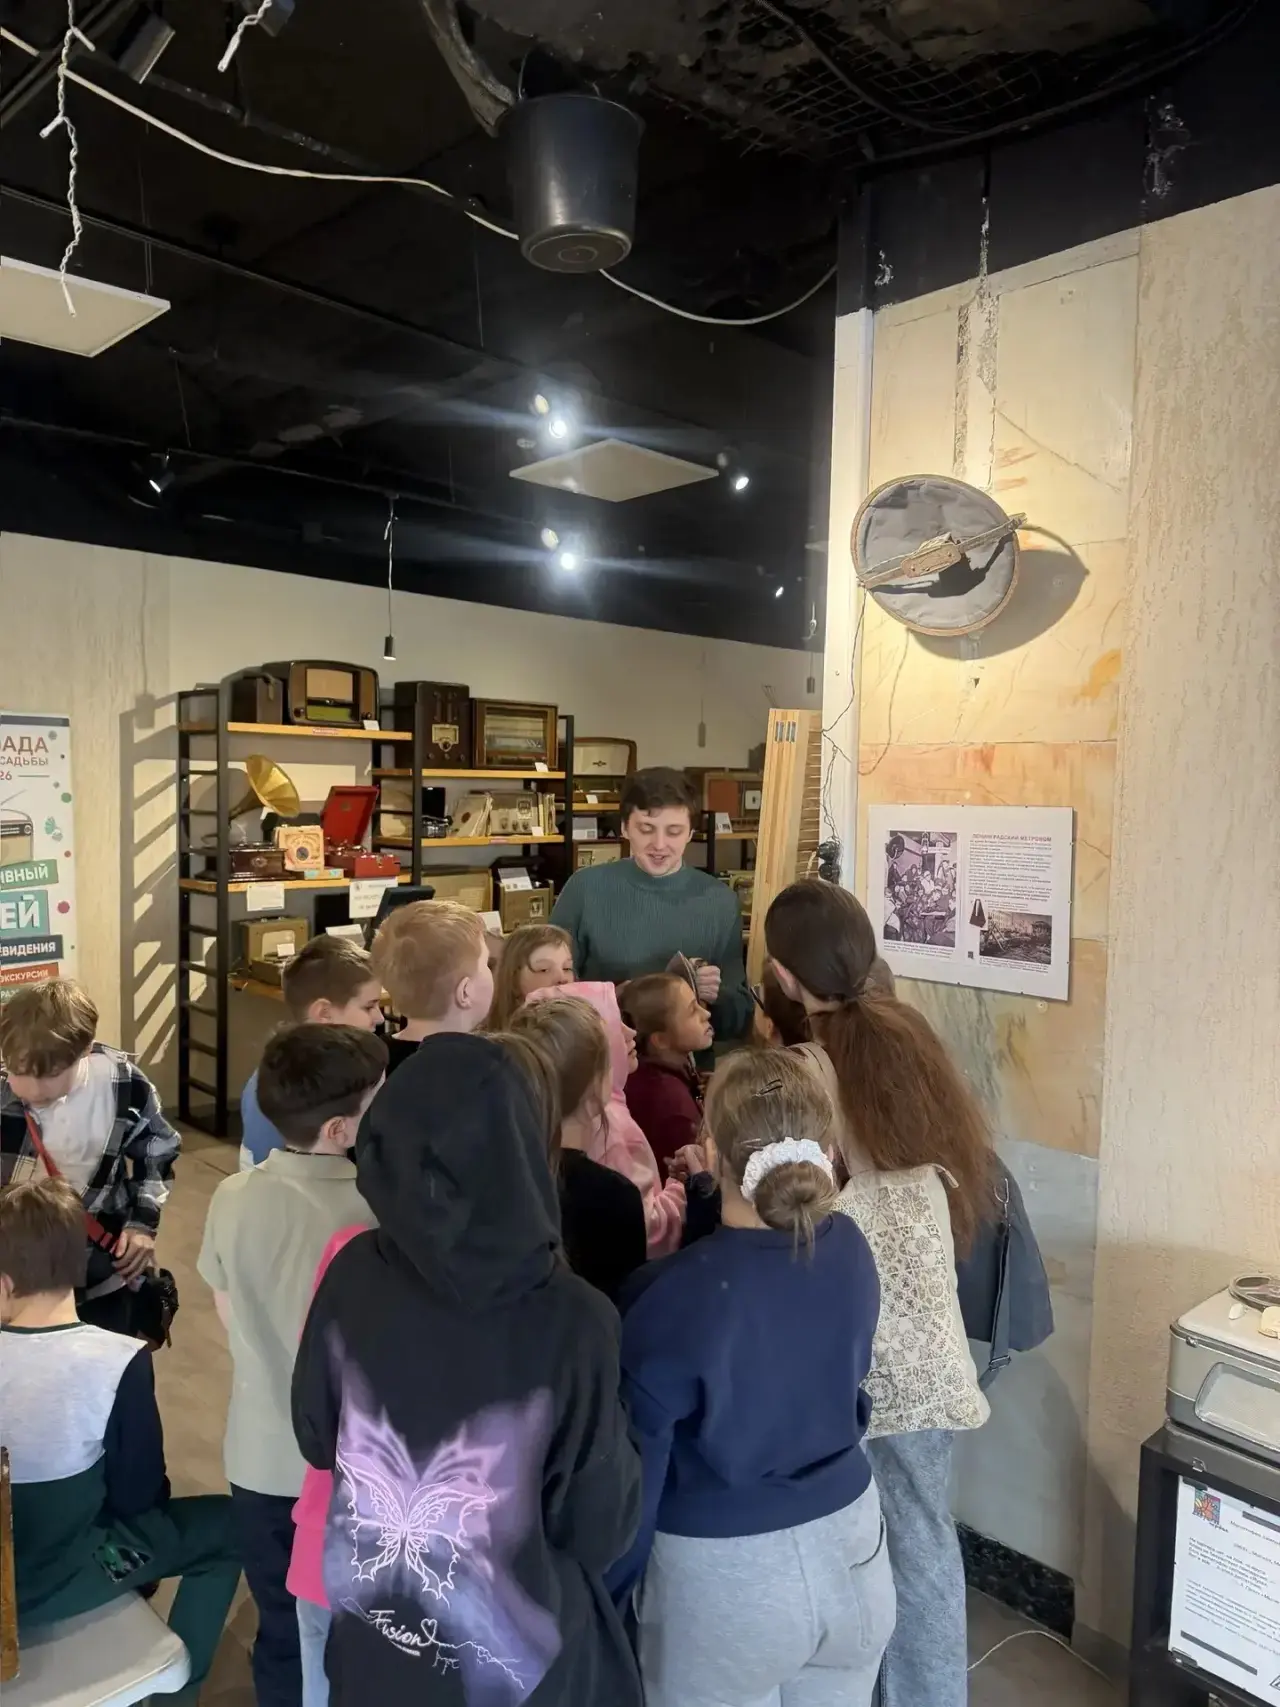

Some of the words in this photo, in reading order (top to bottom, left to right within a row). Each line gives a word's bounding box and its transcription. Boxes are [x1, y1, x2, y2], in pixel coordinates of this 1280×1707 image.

[0, 735, 49, 755] АДА
[0, 894, 40, 928] ЕЙ
[369, 1610, 424, 1647] Fusion
